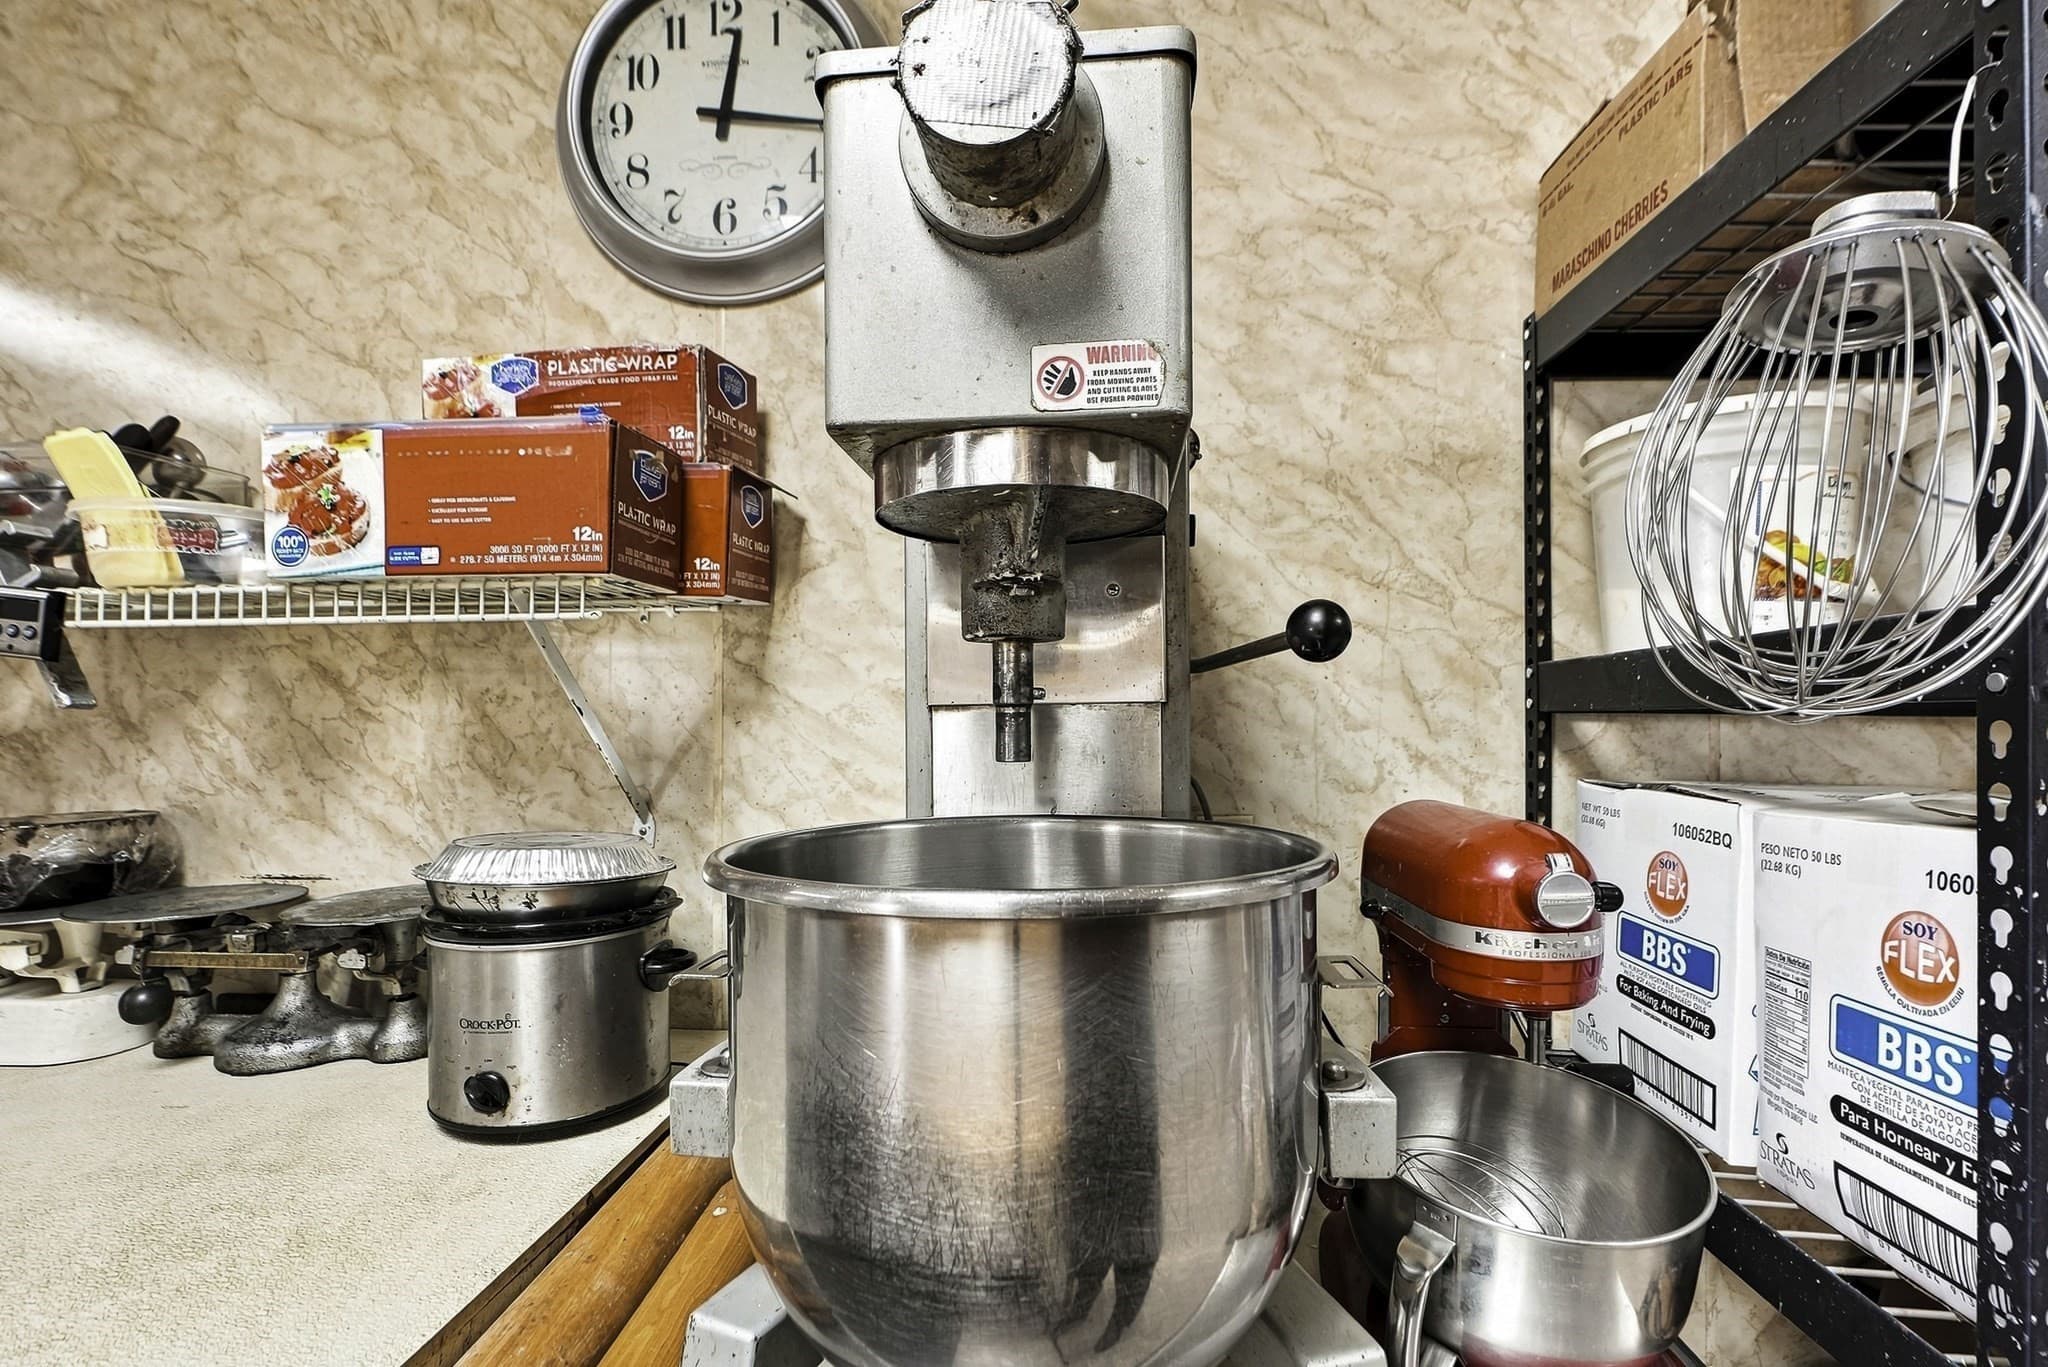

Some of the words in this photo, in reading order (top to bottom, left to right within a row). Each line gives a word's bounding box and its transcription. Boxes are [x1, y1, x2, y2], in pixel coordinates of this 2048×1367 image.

[665, 14, 686, 50] 11
[709, 0, 743, 36] 12
[771, 10, 780, 46] 1
[627, 54, 660, 91] 10
[1618, 90, 1660, 141] PLASTIC
[1663, 59, 1693, 97] JARS
[609, 102, 633, 139] 9
[626, 153, 650, 190] 8
[798, 146, 823, 184] 4
[664, 187, 686, 225] 7
[712, 198, 737, 235] 6
[762, 184, 788, 220] 5
[1552, 227, 1612, 294] MARASCHINO
[1614, 179, 1668, 242] CHERRIES
[547, 357, 618, 377] PLASTIC
[623, 353, 678, 372] WRAP
[597, 377, 619, 385] GRADE
[620, 376, 640, 384] FOOD
[1107, 377, 1134, 385] MOVING
[1086, 396, 1099, 404] USE
[1100, 395, 1125, 403] PUSHER
[1126, 393, 1159, 402] PROVIDED
[1103, 385, 1131, 394] CUTTING
[668, 425, 695, 440] 12in
[707, 404, 737, 429] PLASTIC
[572, 526, 603, 541] 12in
[617, 501, 651, 527] PLASTIC
[652, 515, 676, 536] WRAP
[490, 545, 509, 554] 3000
[511, 545, 522, 553] SQ
[524, 545, 534, 553] FT
[536, 545, 559, 553] (3000
[560, 544, 570, 552] FT
[572, 544, 577, 552] X
[579, 544, 590, 552] 12
[732, 532, 753, 550] PLASTIC
[459, 555, 482, 564] 278.7
[484, 555, 495, 563] SQ
[496, 554, 527, 563] METERS
[529, 554, 562, 564] (914.4m
[693, 557, 720, 570] 12in
[700, 572, 709, 580] 12
[1672, 822, 1733, 849] 106052BQ
[1659, 858, 1678, 871] SOY
[1760, 859, 1784, 873] (22.68
[1785, 862, 1802, 878] KG)
[1761, 843, 1782, 856] PESO
[1783, 846, 1809, 861] NETO
[1811, 850, 1822, 863] 50
[1824, 853, 1842, 866] LBS
[1649, 871, 1686, 901] FLEX
[1925, 869, 1978, 895] 1060
[1902, 921, 1938, 941] SOY
[1502, 949, 1577, 959] PROFESSIONAL
[1641, 929, 1687, 977] BBS
[1884, 940, 1957, 984] FLEX
[1619, 977, 1632, 992] For
[1633, 985, 1659, 1011] Baking
[1660, 1000, 1679, 1018] And
[1680, 1009, 1711, 1037] Frying
[1795, 988, 1809, 1001] 110
[1876, 965, 1896, 999] SEMILLA
[1896, 998, 1939, 1017] CULTIVADA
[1949, 986, 1965, 1009] EEUU
[1877, 1021, 1964, 1097] BBS
[1828, 1060, 1866, 1083] MANTECA
[1867, 1077, 1903, 1101] VEGETAL
[1906, 1094, 1931, 1112] PARA
[1933, 1105, 1963, 1126] TODO
[1851, 1081, 1871, 1096] CON
[1872, 1091, 1902, 1111] ACEITE
[1905, 1105, 1917, 1117] DE
[1919, 1111, 1946, 1131] SOYA
[1860, 1094, 1872, 1107] DE
[1873, 1100, 1908, 1125] SEMILLA
[1911, 1118, 1924, 1131] DE
[1840, 1102, 1870, 1131] Para
[1874, 1117, 1941, 1164] Hornear
[1945, 1156, 1956, 1176] y
[1760, 1139, 1816, 1190] STRATAS
